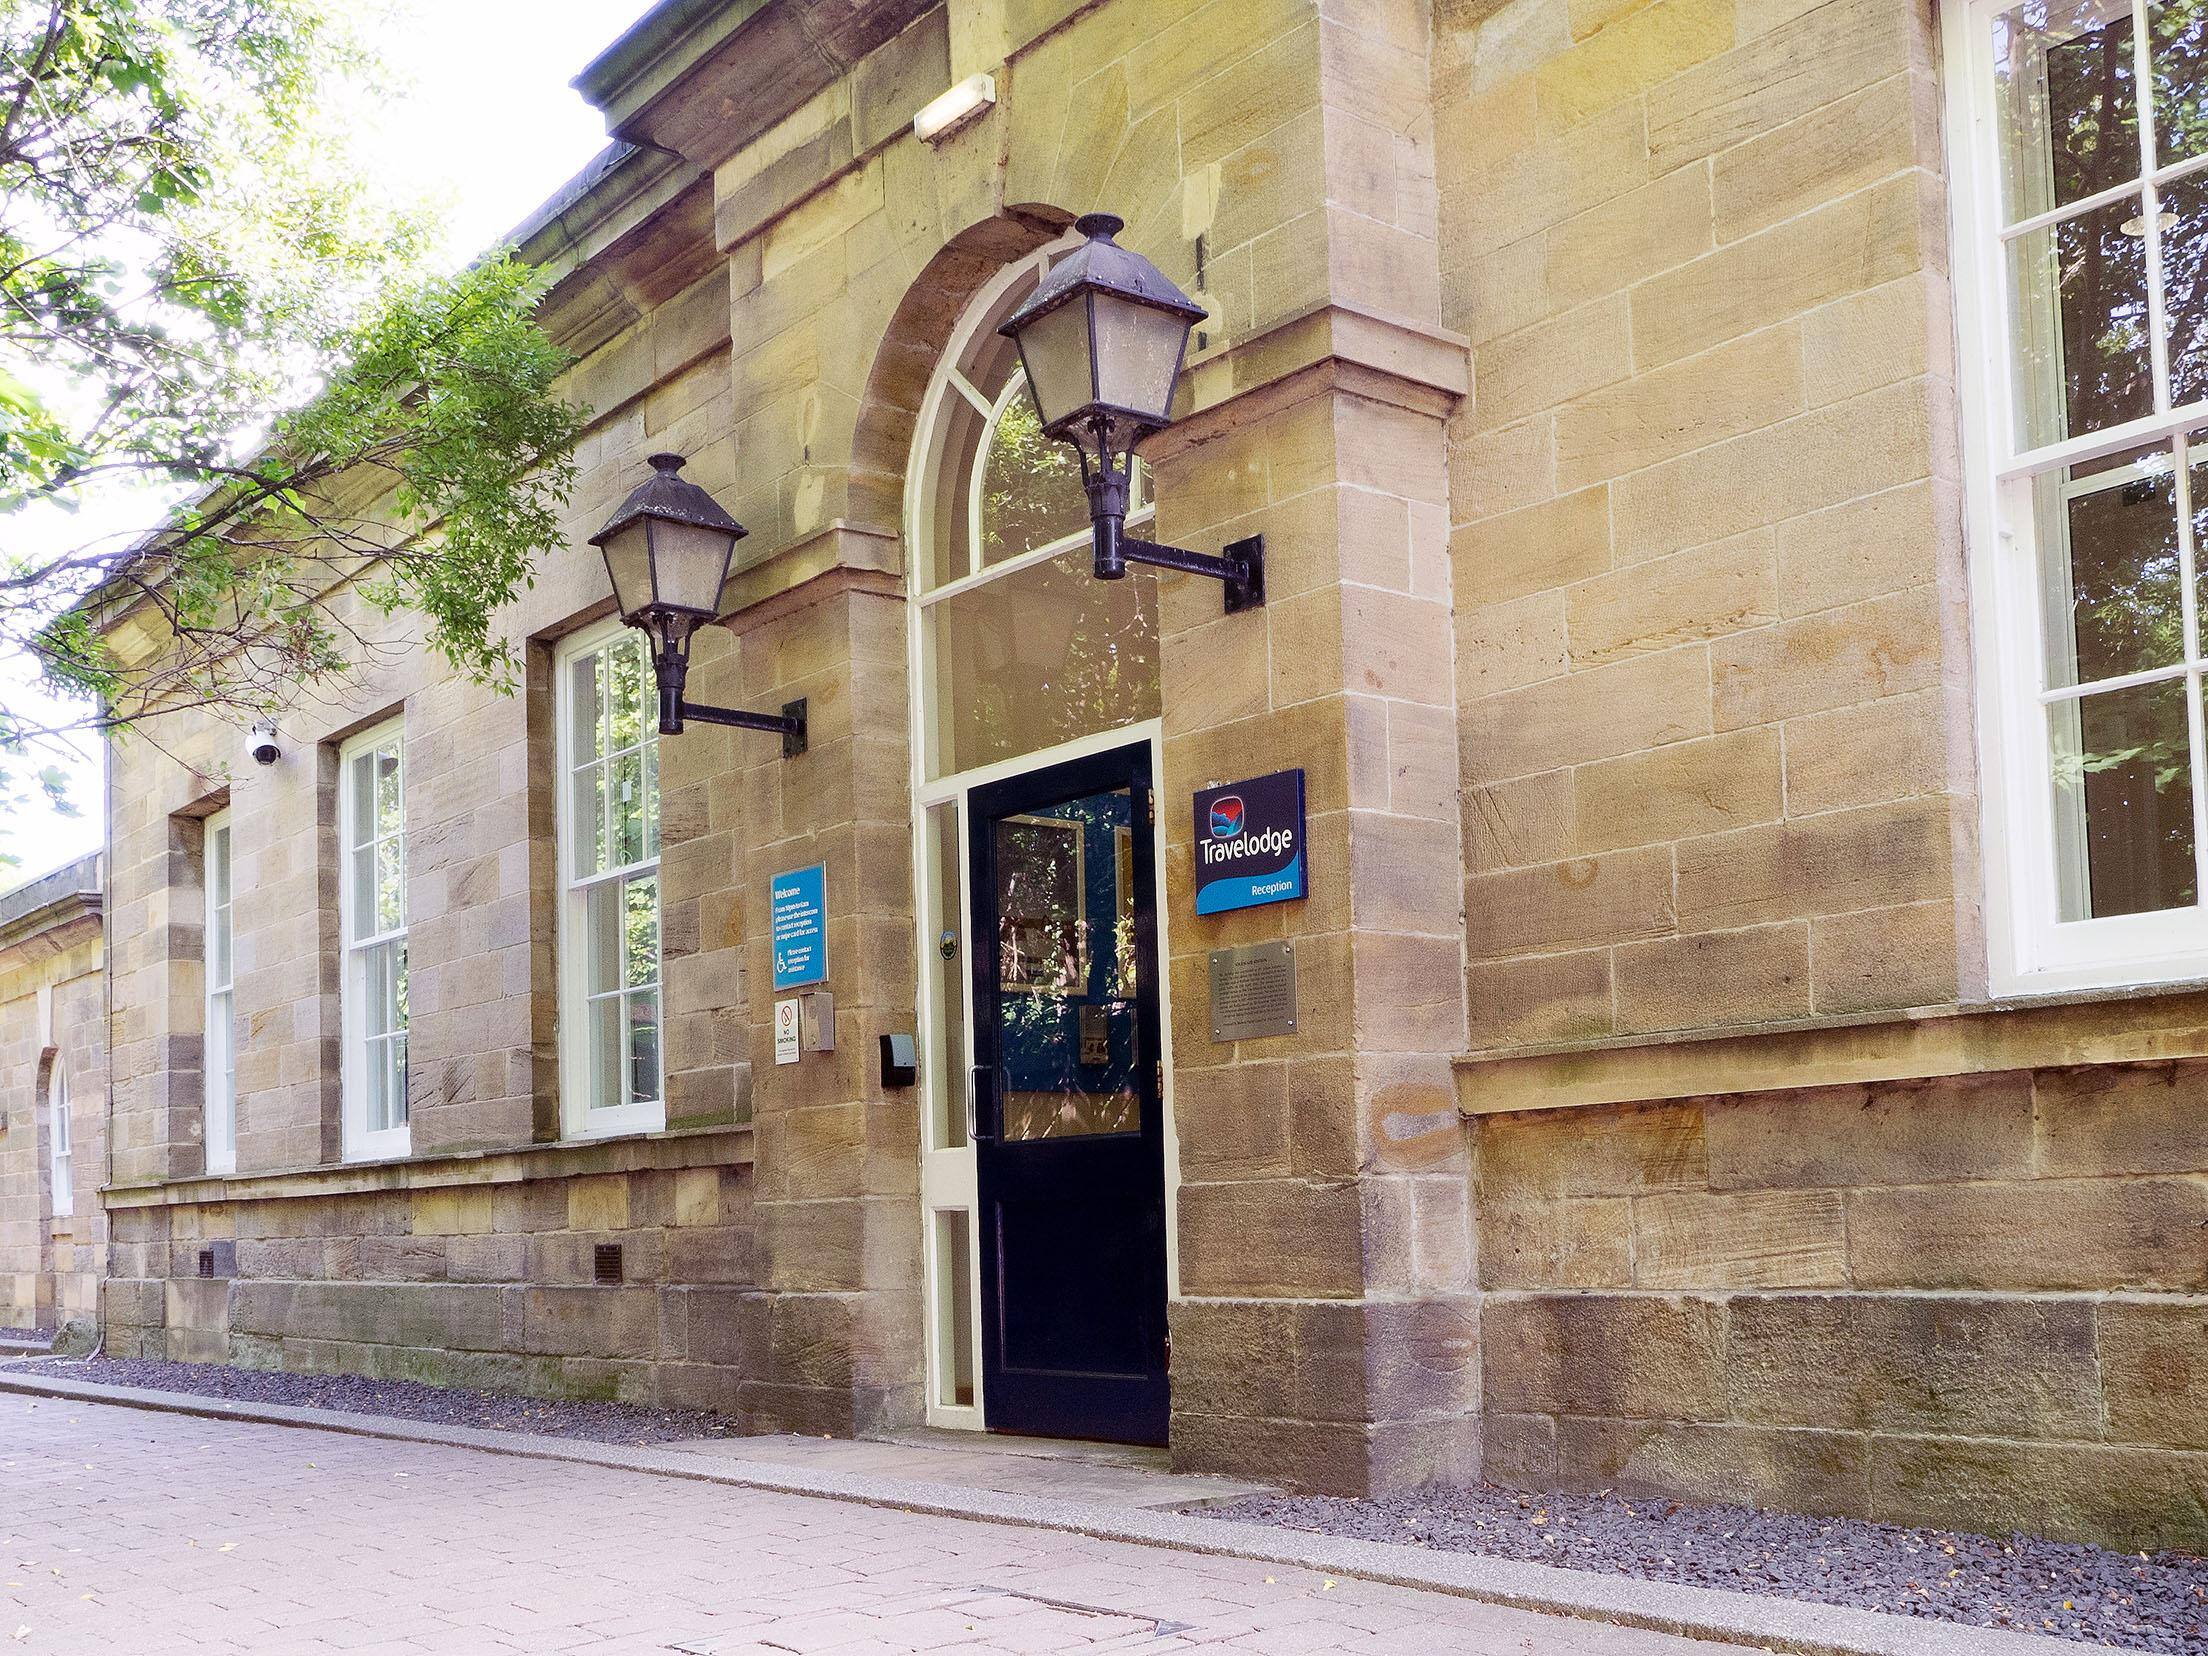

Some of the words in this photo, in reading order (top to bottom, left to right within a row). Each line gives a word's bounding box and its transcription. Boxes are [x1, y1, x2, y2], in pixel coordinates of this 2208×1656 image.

[1200, 826, 1292, 864] Travelodge
[775, 887, 800, 900] Welcome
[1251, 881, 1293, 896] Reception
[777, 1036, 796, 1044] SMOKING
